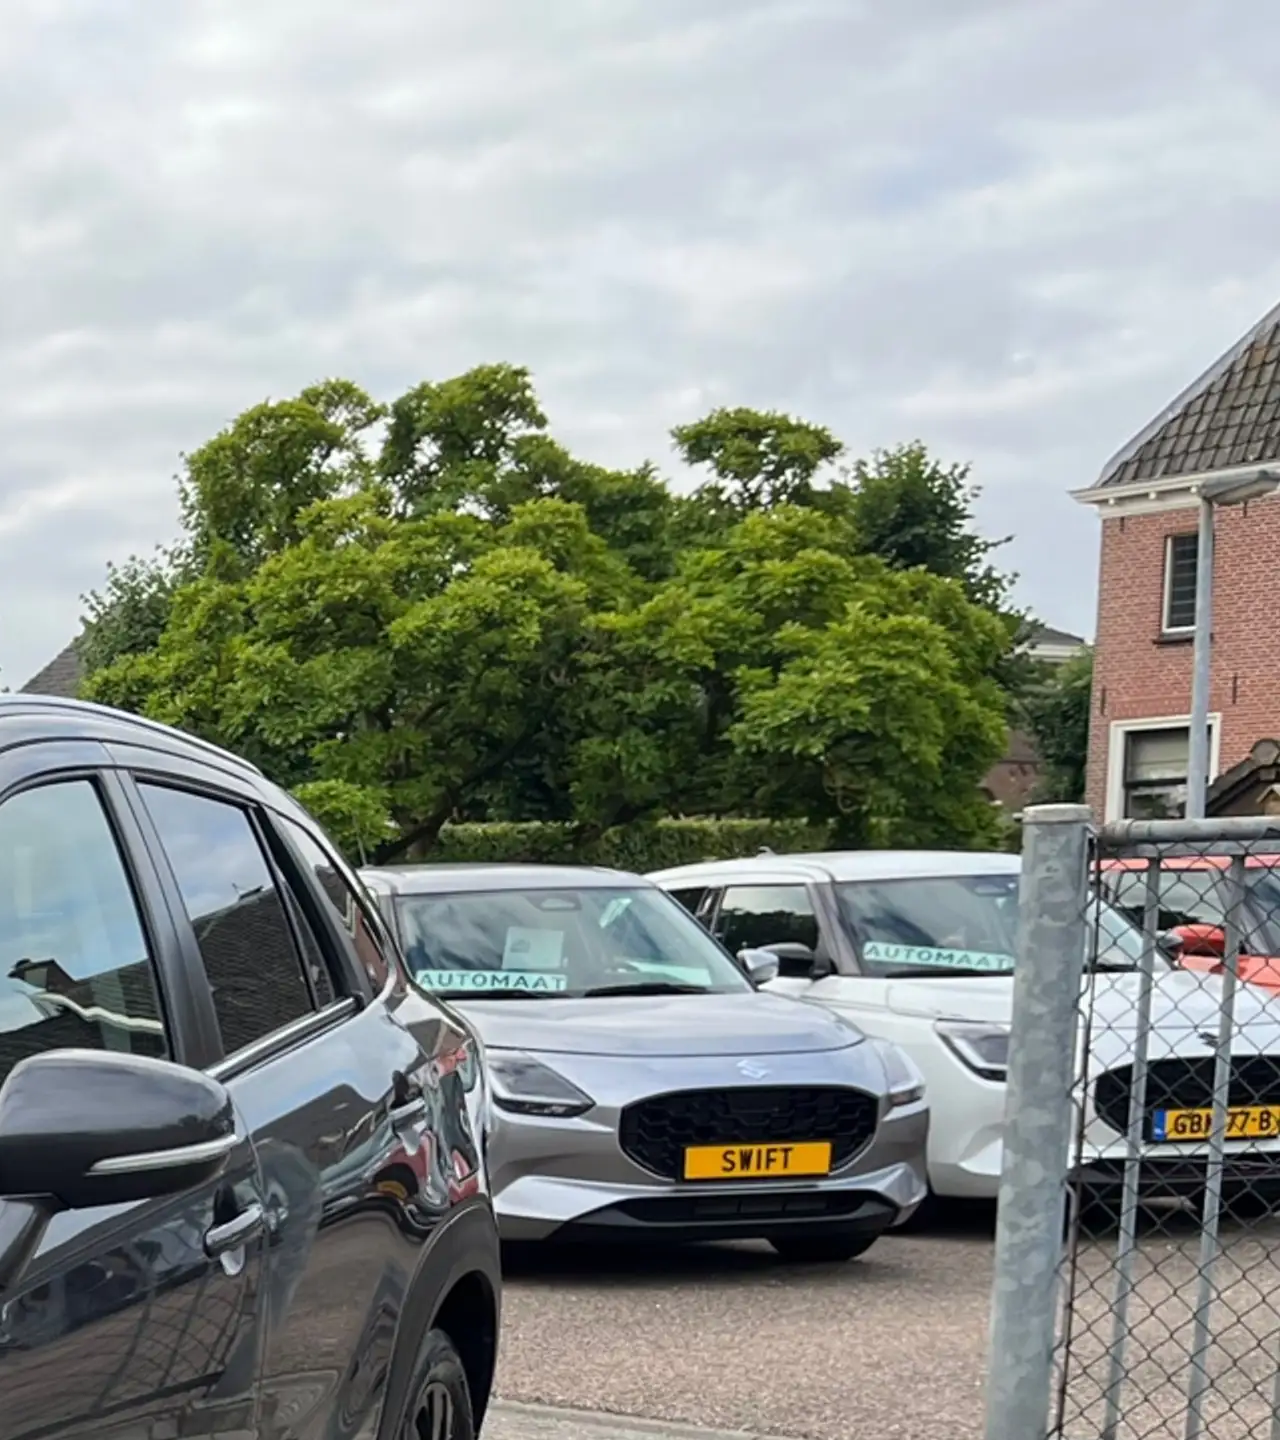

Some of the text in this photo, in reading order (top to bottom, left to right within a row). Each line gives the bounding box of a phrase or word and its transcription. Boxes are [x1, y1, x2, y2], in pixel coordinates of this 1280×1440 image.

[864, 943, 1010, 971] AUTOMAAT
[419, 973, 567, 991] AUTOMAAT
[721, 1147, 794, 1172] SWIFT
